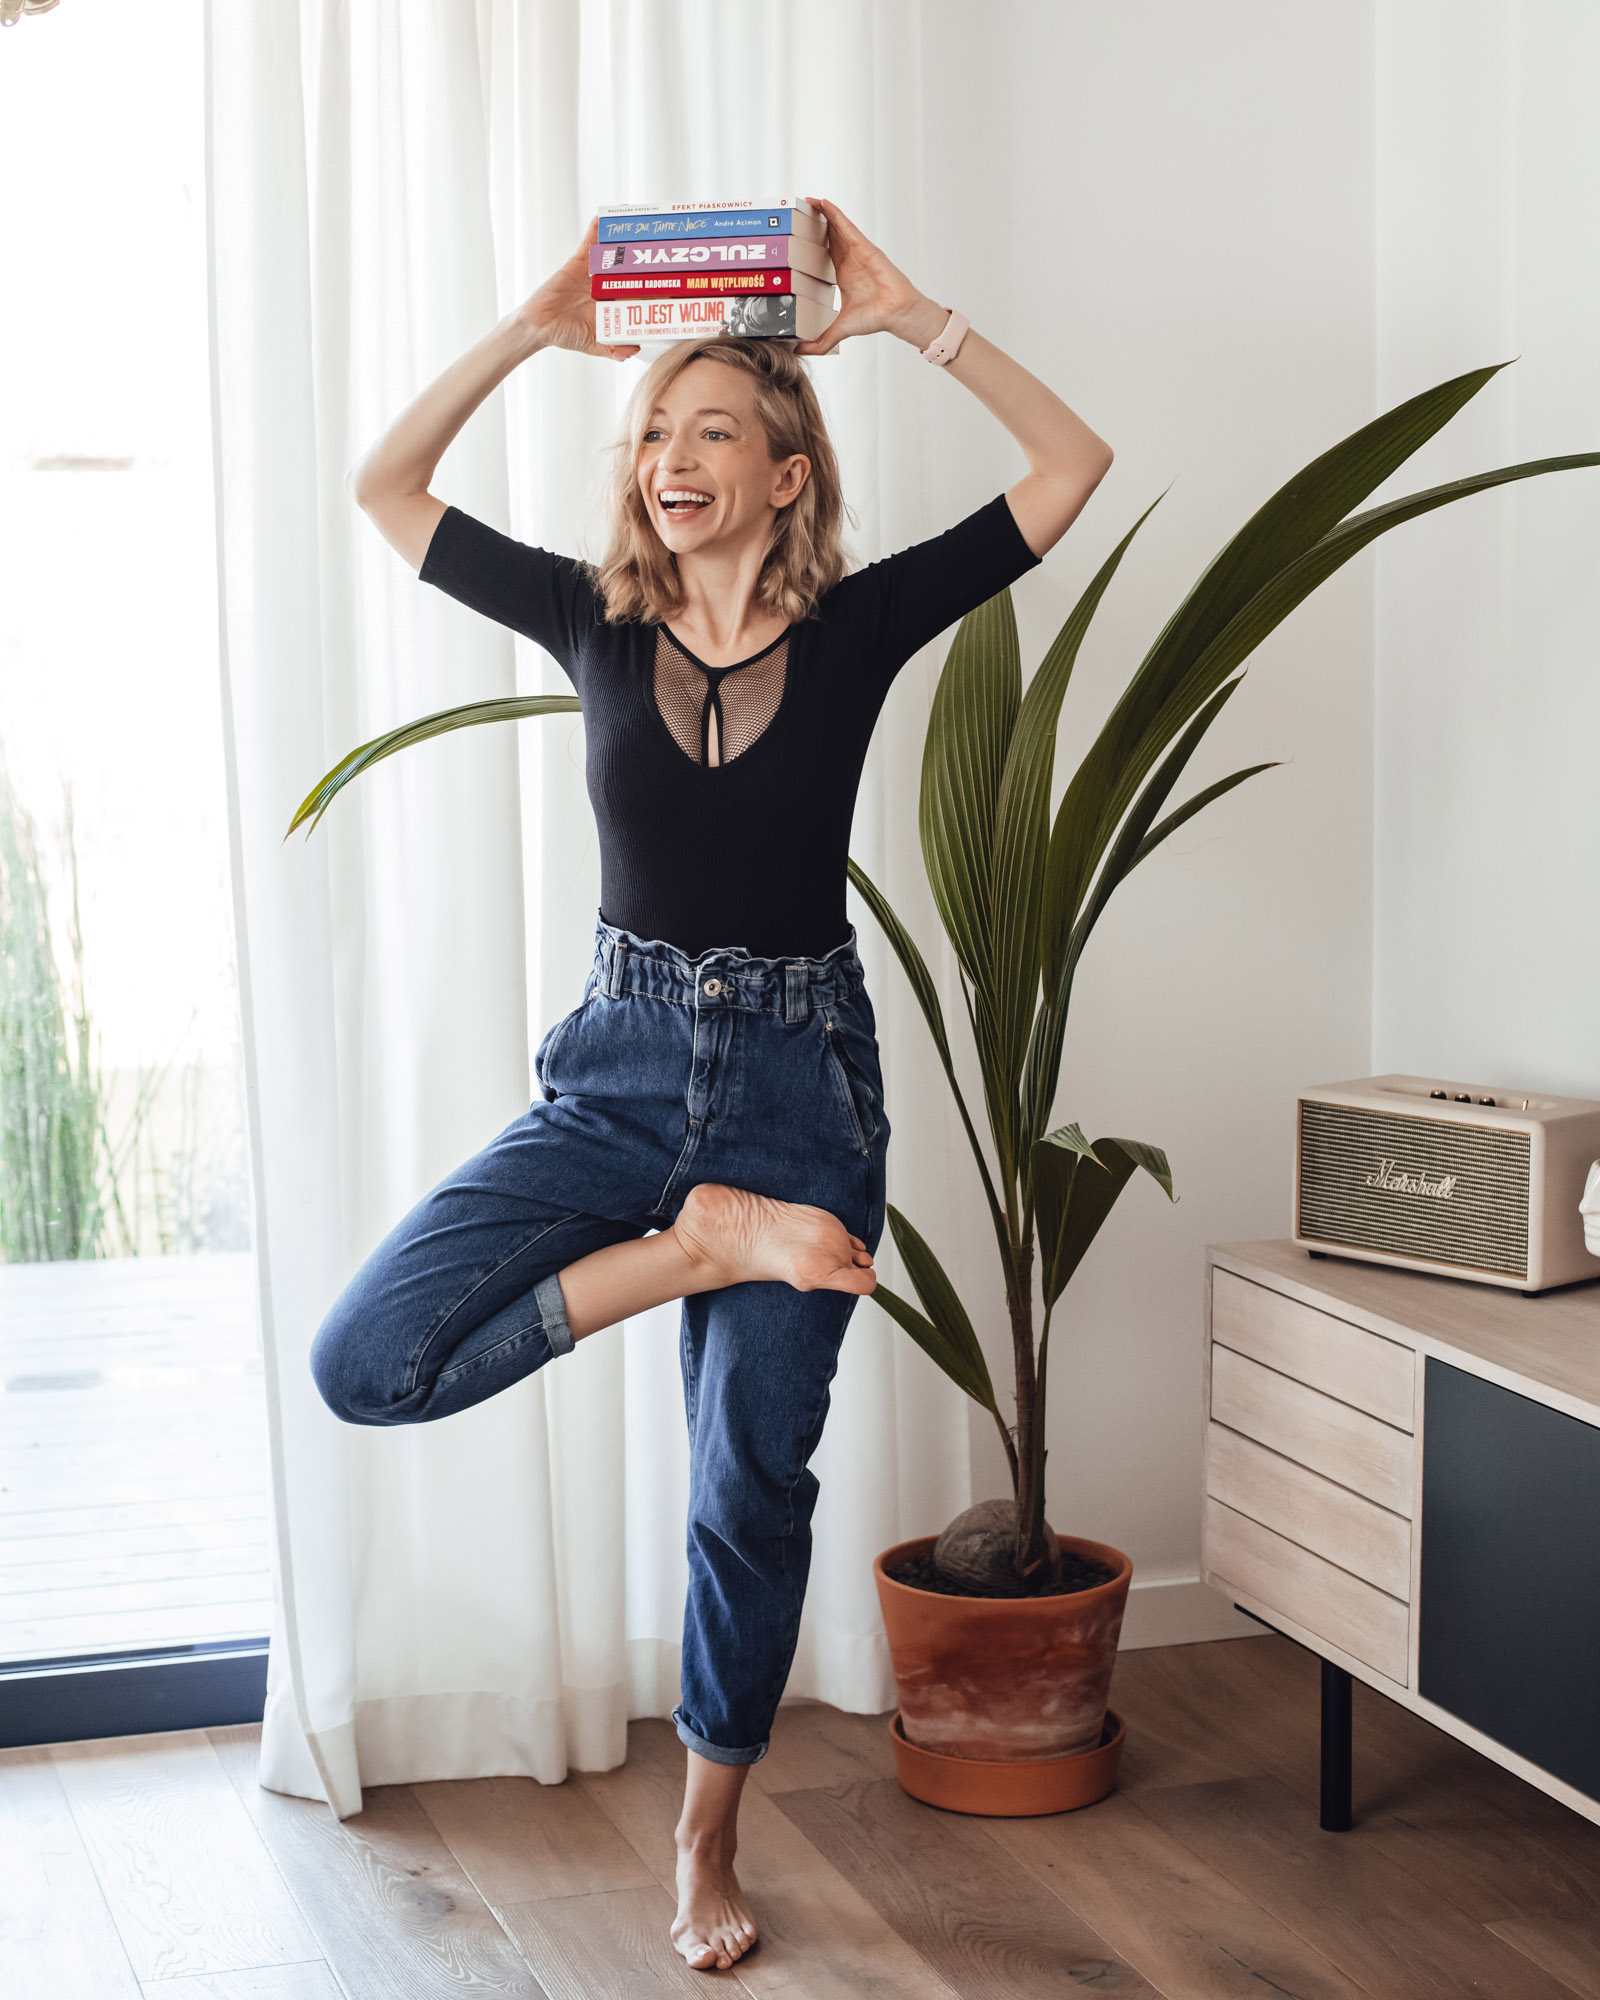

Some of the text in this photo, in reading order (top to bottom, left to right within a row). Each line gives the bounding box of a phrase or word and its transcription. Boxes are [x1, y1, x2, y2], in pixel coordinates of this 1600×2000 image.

[672, 201, 753, 211] EFEKT PIASKOWNICY
[714, 218, 762, 227] André Aciman
[602, 279, 681, 290] ALEKSANDRA RADOMSKA
[686, 274, 765, 291] MAM WĄTPLIWOŚĆ
[626, 300, 725, 326] TO JEST WOJNA
[1365, 1158, 1457, 1199] Marshall
